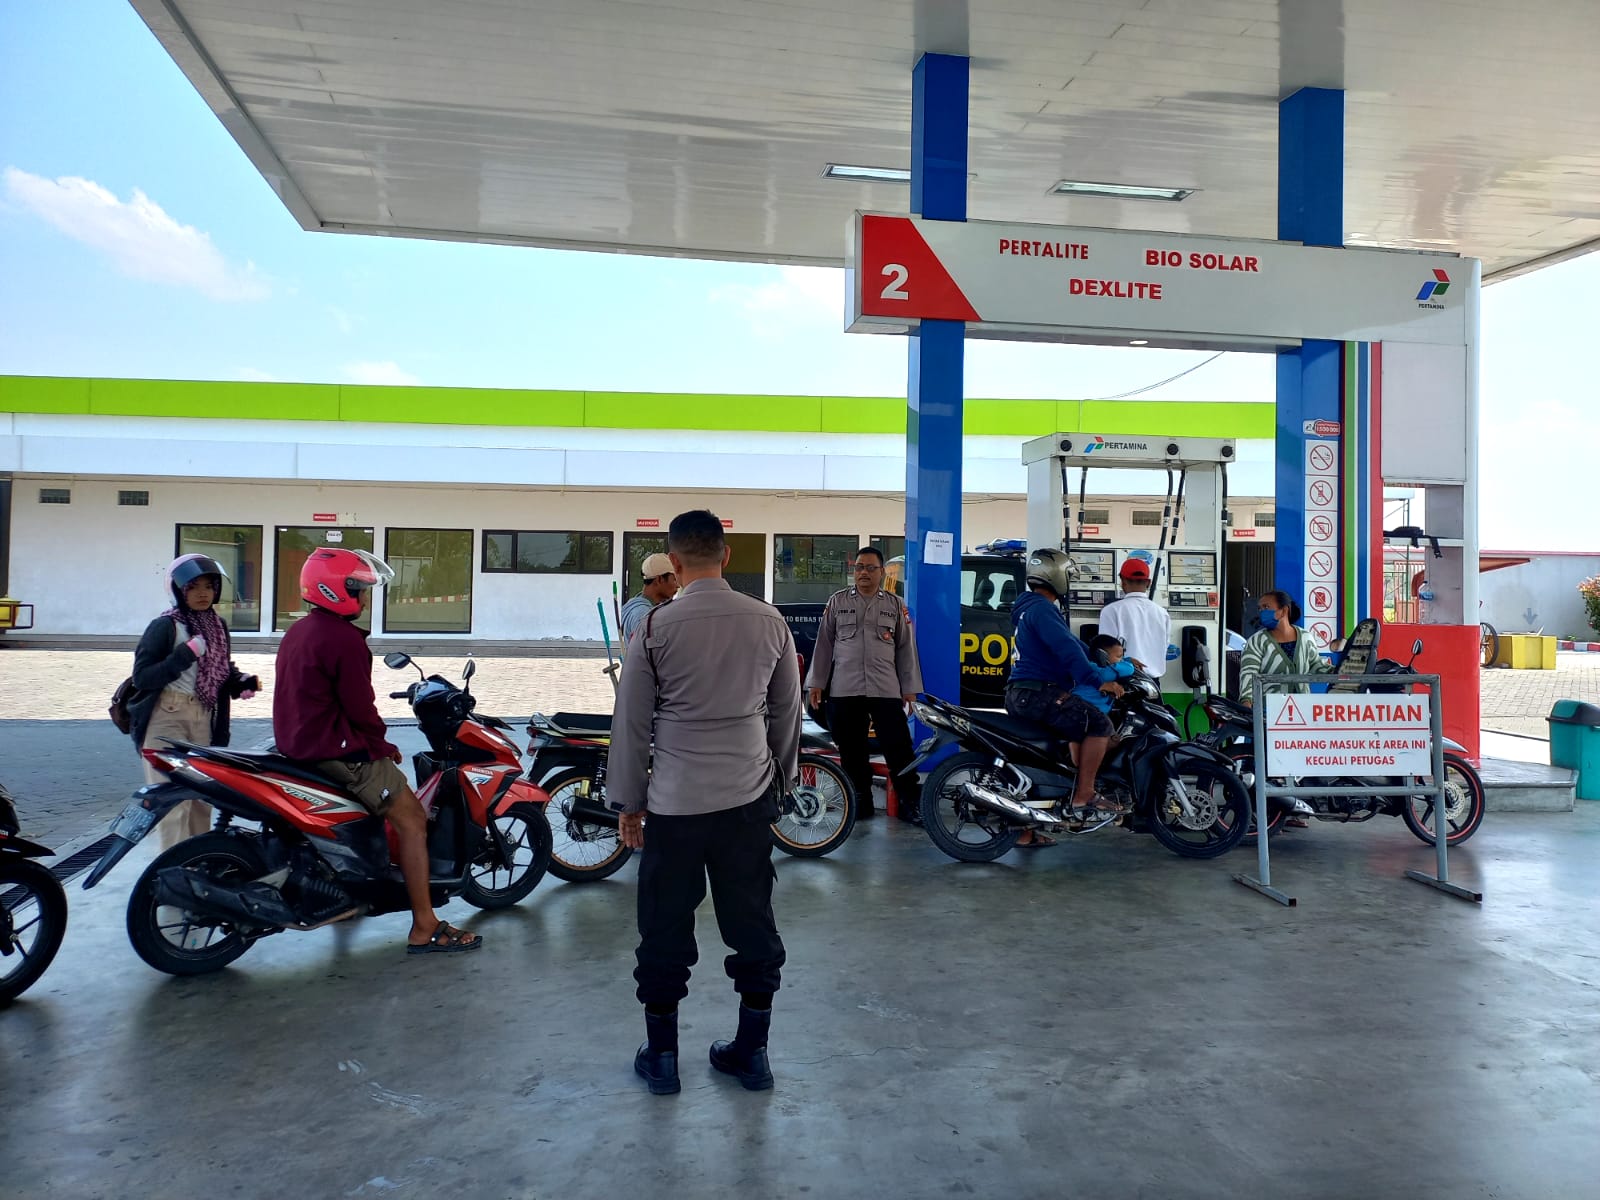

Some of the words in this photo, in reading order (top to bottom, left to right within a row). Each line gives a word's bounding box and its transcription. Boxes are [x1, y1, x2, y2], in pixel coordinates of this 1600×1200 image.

[999, 238, 1089, 260] PERTALITE
[1146, 249, 1183, 268] BIO
[1189, 253, 1259, 273] SOLAR
[880, 263, 909, 300] 2
[1069, 278, 1162, 300] DEXLITE
[1104, 441, 1148, 451] PERTAMINA
[962, 665, 1004, 676] POLSEK
[1312, 704, 1422, 722] PERHATIAN
[1274, 740, 1327, 750] DILARANG
[1330, 740, 1366, 750] MASUK
[1369, 740, 1381, 750] KE
[1384, 740, 1409, 750] AREA
[1411, 740, 1426, 750] INI
[1305, 755, 1347, 766] KECUALI
[1350, 755, 1395, 766] PETUGAS
